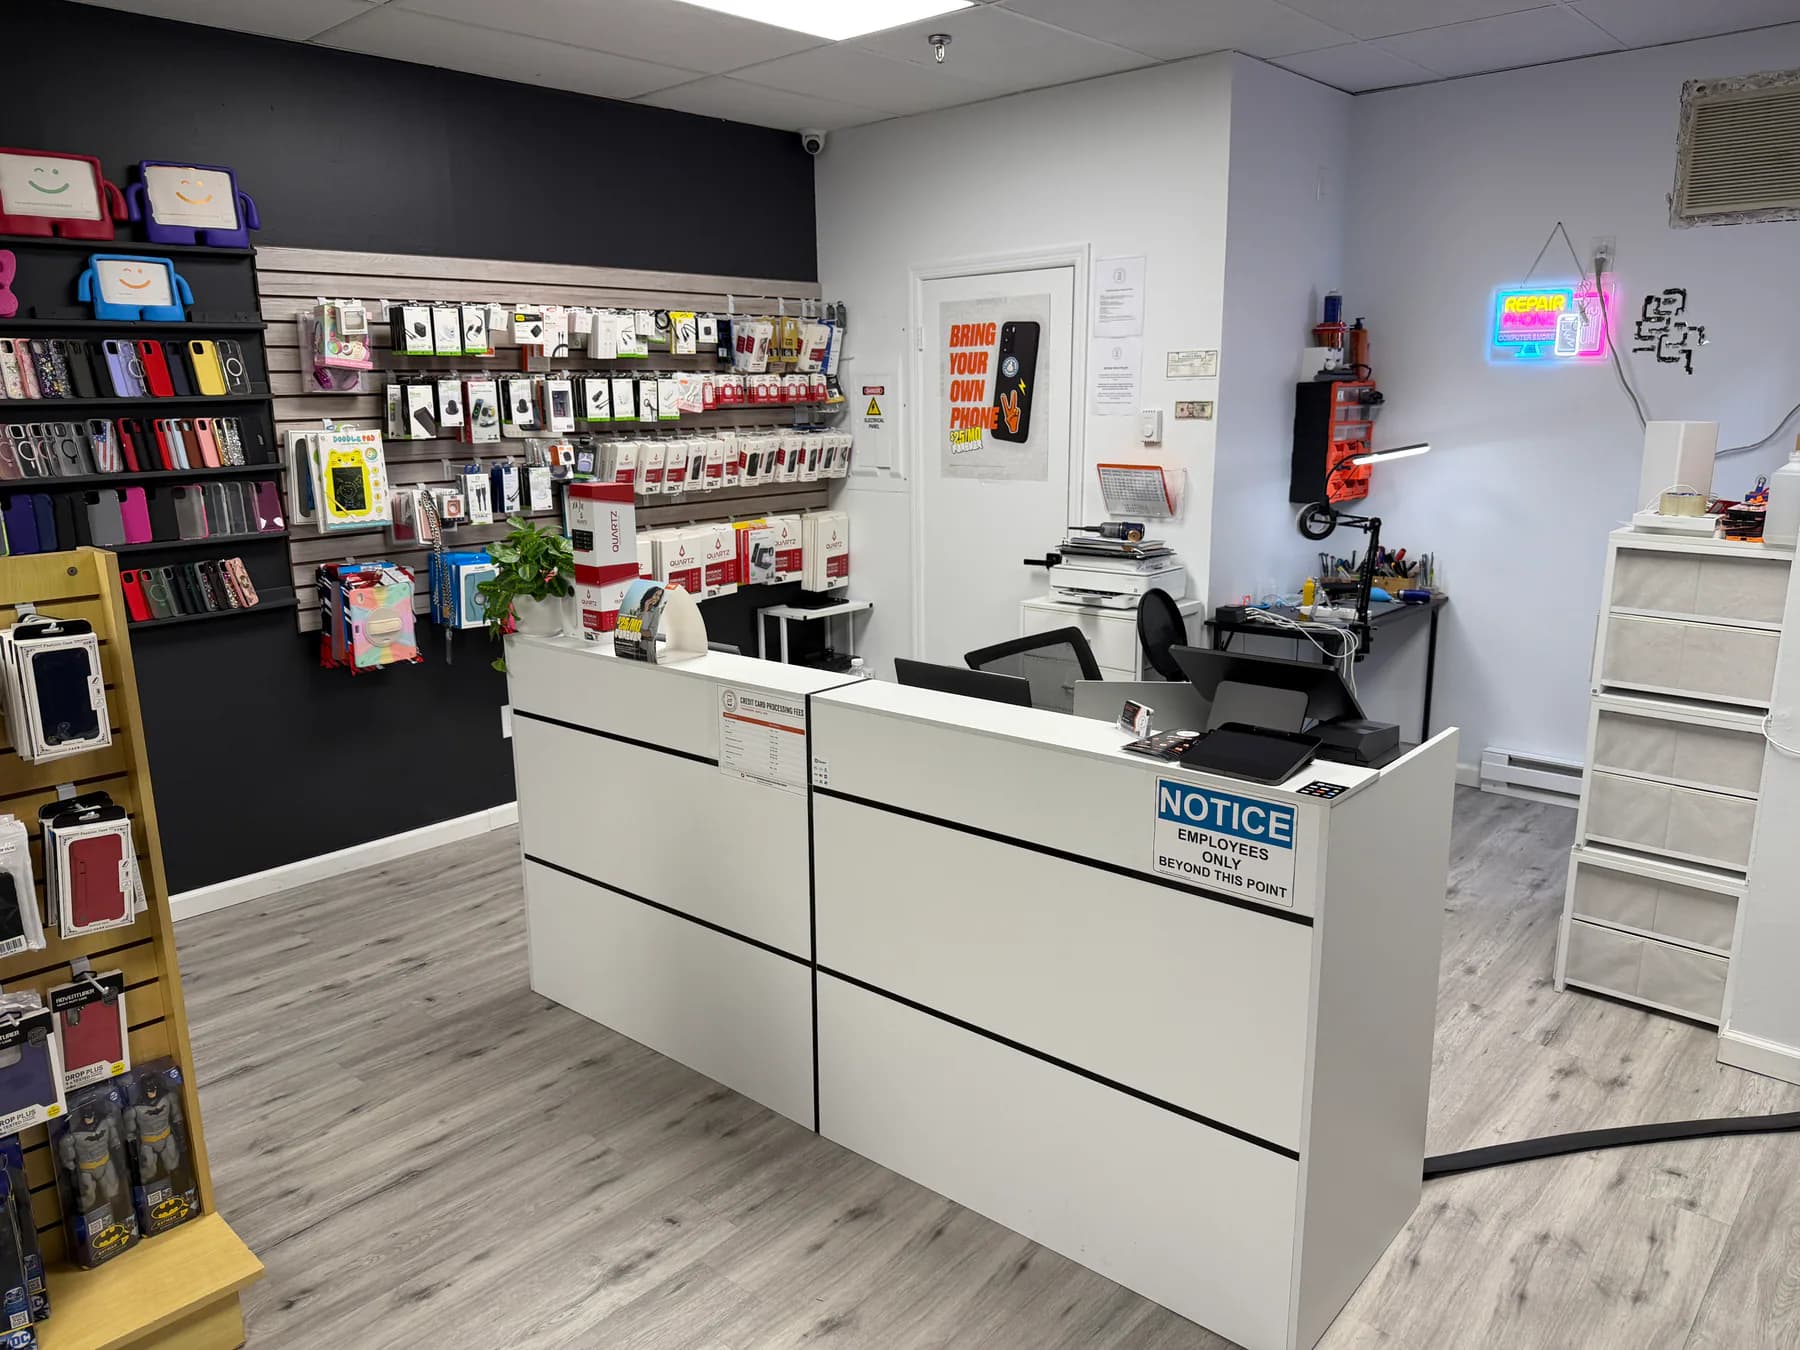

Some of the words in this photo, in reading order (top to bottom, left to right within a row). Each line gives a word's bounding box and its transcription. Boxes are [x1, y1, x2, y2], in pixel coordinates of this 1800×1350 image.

[1505, 295, 1565, 312] REPAIR
[1503, 311, 1557, 328] PHONE
[950, 322, 997, 347] BRING
[950, 352, 988, 375] YOUR
[950, 379, 985, 403] OWN
[950, 407, 1000, 430] PHONE
[333, 435, 361, 443] DOODLE
[950, 427, 982, 445] $25/MO
[611, 511, 620, 552] QUARTZ
[670, 557, 695, 567] QUARTZ
[707, 549, 730, 559] QUARTZ
[617, 616, 643, 633] $25/MO
[740, 697, 754, 706] CREDIT
[755, 700, 766, 709] CARD
[766, 702, 793, 714] PROCESSING
[793, 707, 804, 717] FEES
[1160, 787, 1292, 842] NOTICE
[1178, 828, 1269, 860] EMPLOYEES
[1202, 851, 1242, 871] ONLY
[1159, 856, 1210, 878] BEYOND
[1214, 870, 1243, 887] THIS
[1247, 878, 1287, 898] POINT
[65, 1071, 85, 1082] DROP
[85, 1065, 104, 1076] PLUS
[0, 1116, 15, 1127] ROP
[17, 1109, 36, 1121] PLUS
[10, 1333, 29, 1347] DC
